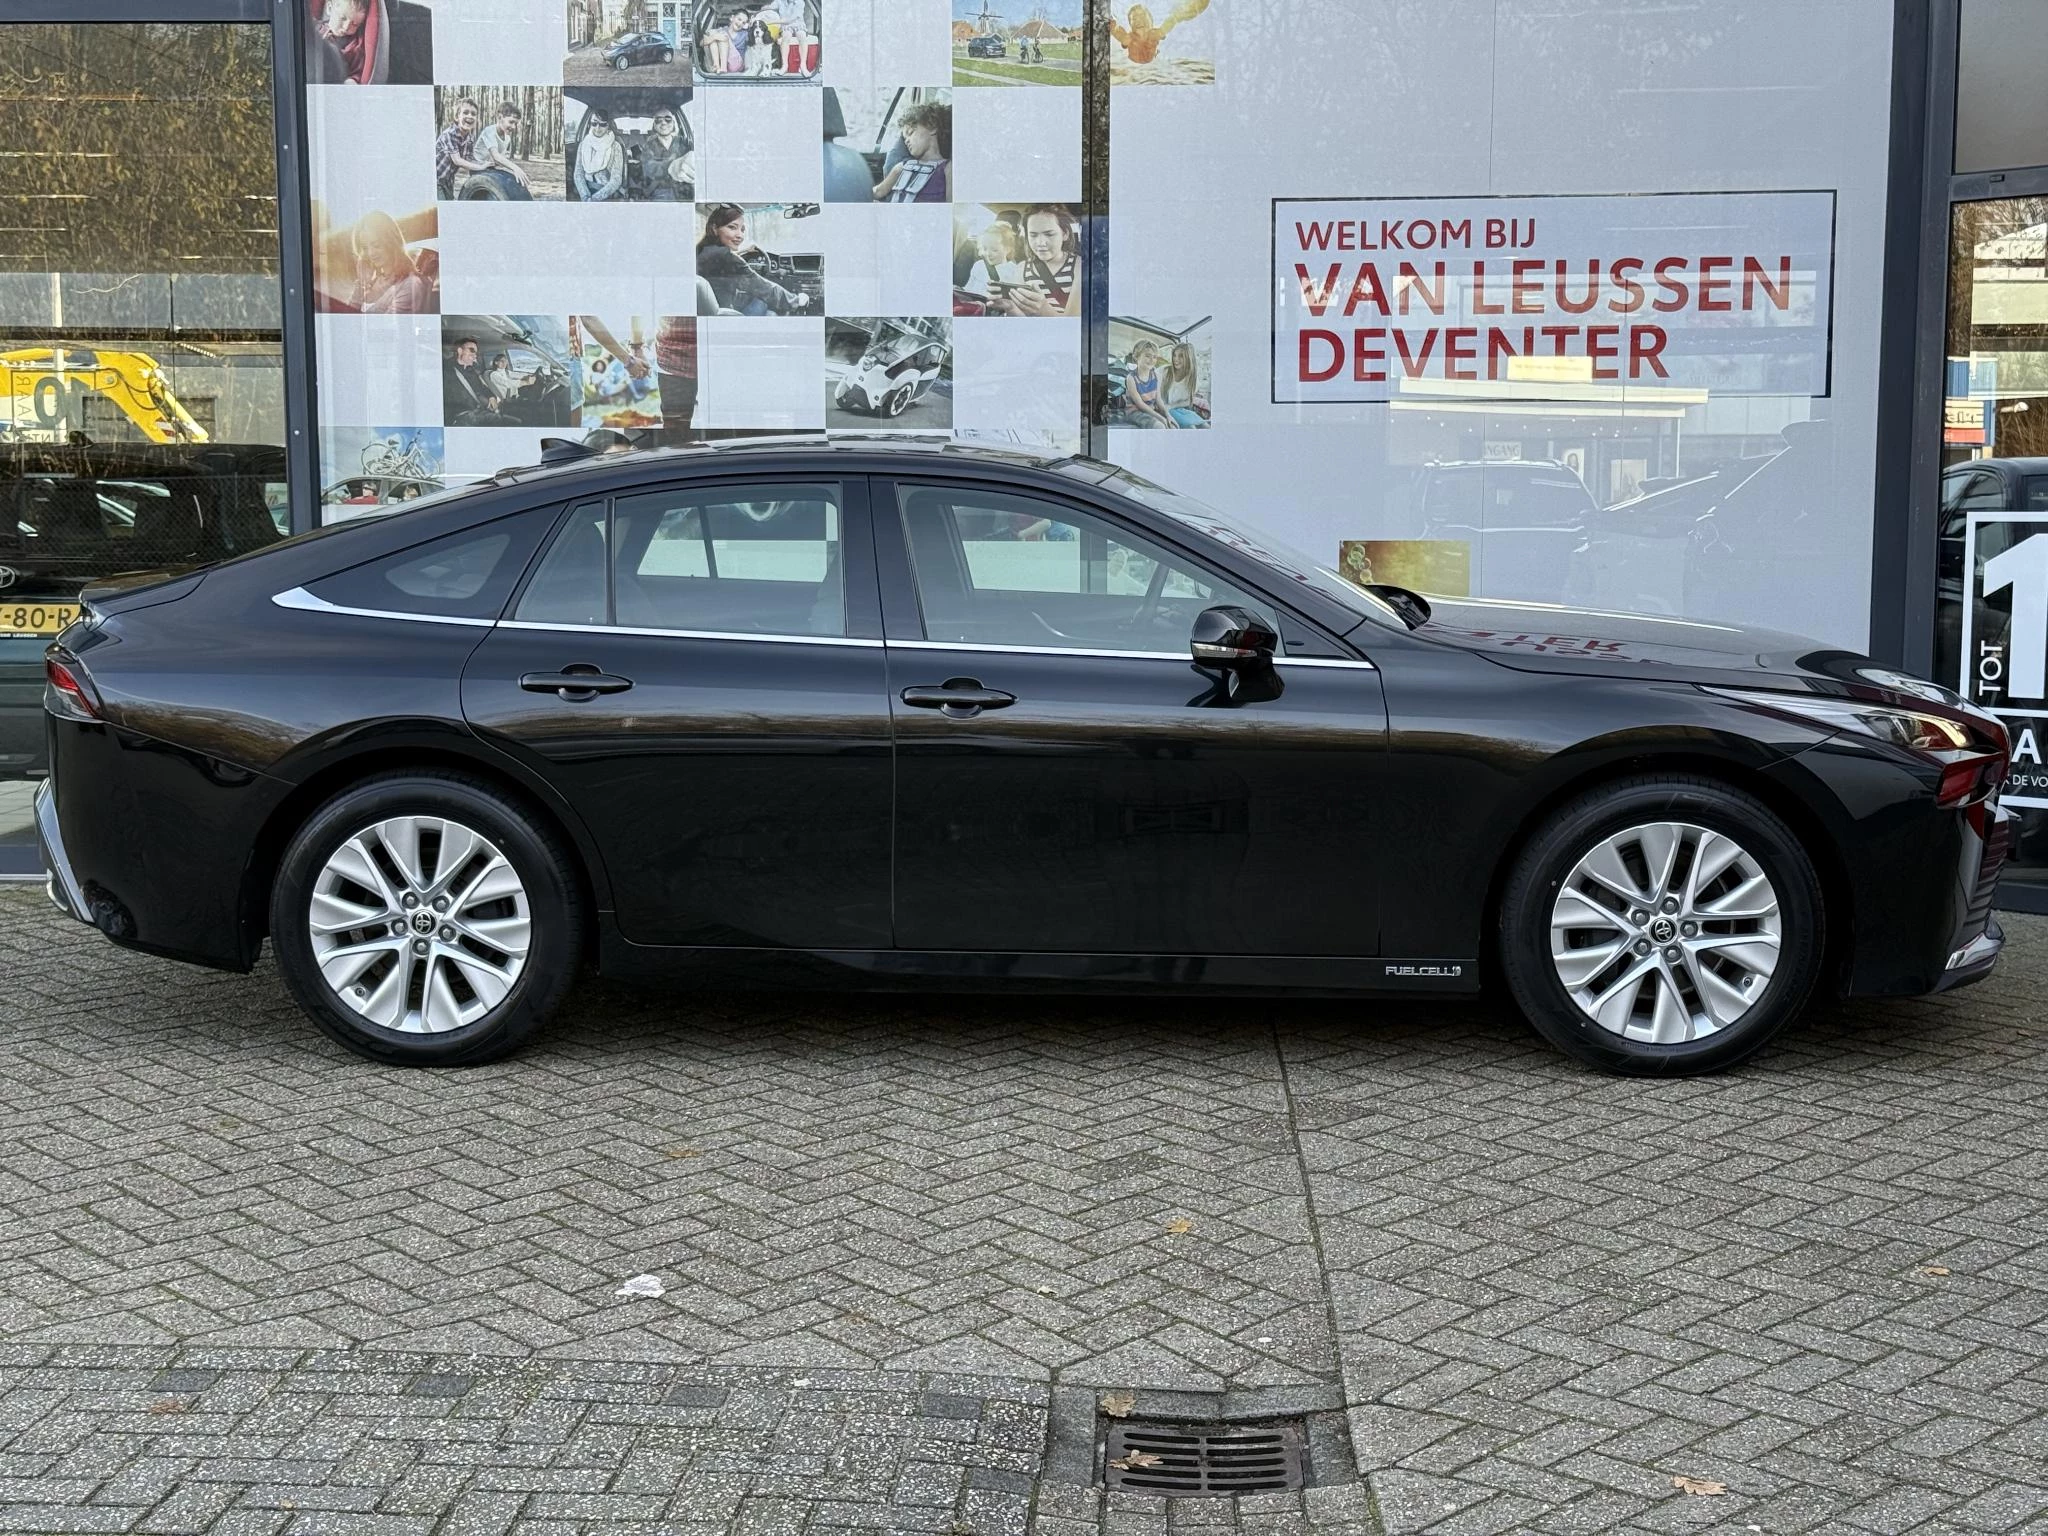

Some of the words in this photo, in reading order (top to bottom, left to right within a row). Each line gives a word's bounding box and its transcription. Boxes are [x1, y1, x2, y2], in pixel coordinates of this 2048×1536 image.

[1295, 219, 1472, 251] WELKOM
[1485, 218, 1536, 249] BIJ
[1294, 262, 1446, 317] VAN
[1472, 255, 1792, 315] LEUSSEN
[1298, 323, 1671, 383] DEVENTER
[0, 607, 72, 629] -80-R
[1978, 640, 2003, 697] TOT
[2012, 774, 2028, 786] DE
[1385, 966, 1455, 976] FUELCELL
